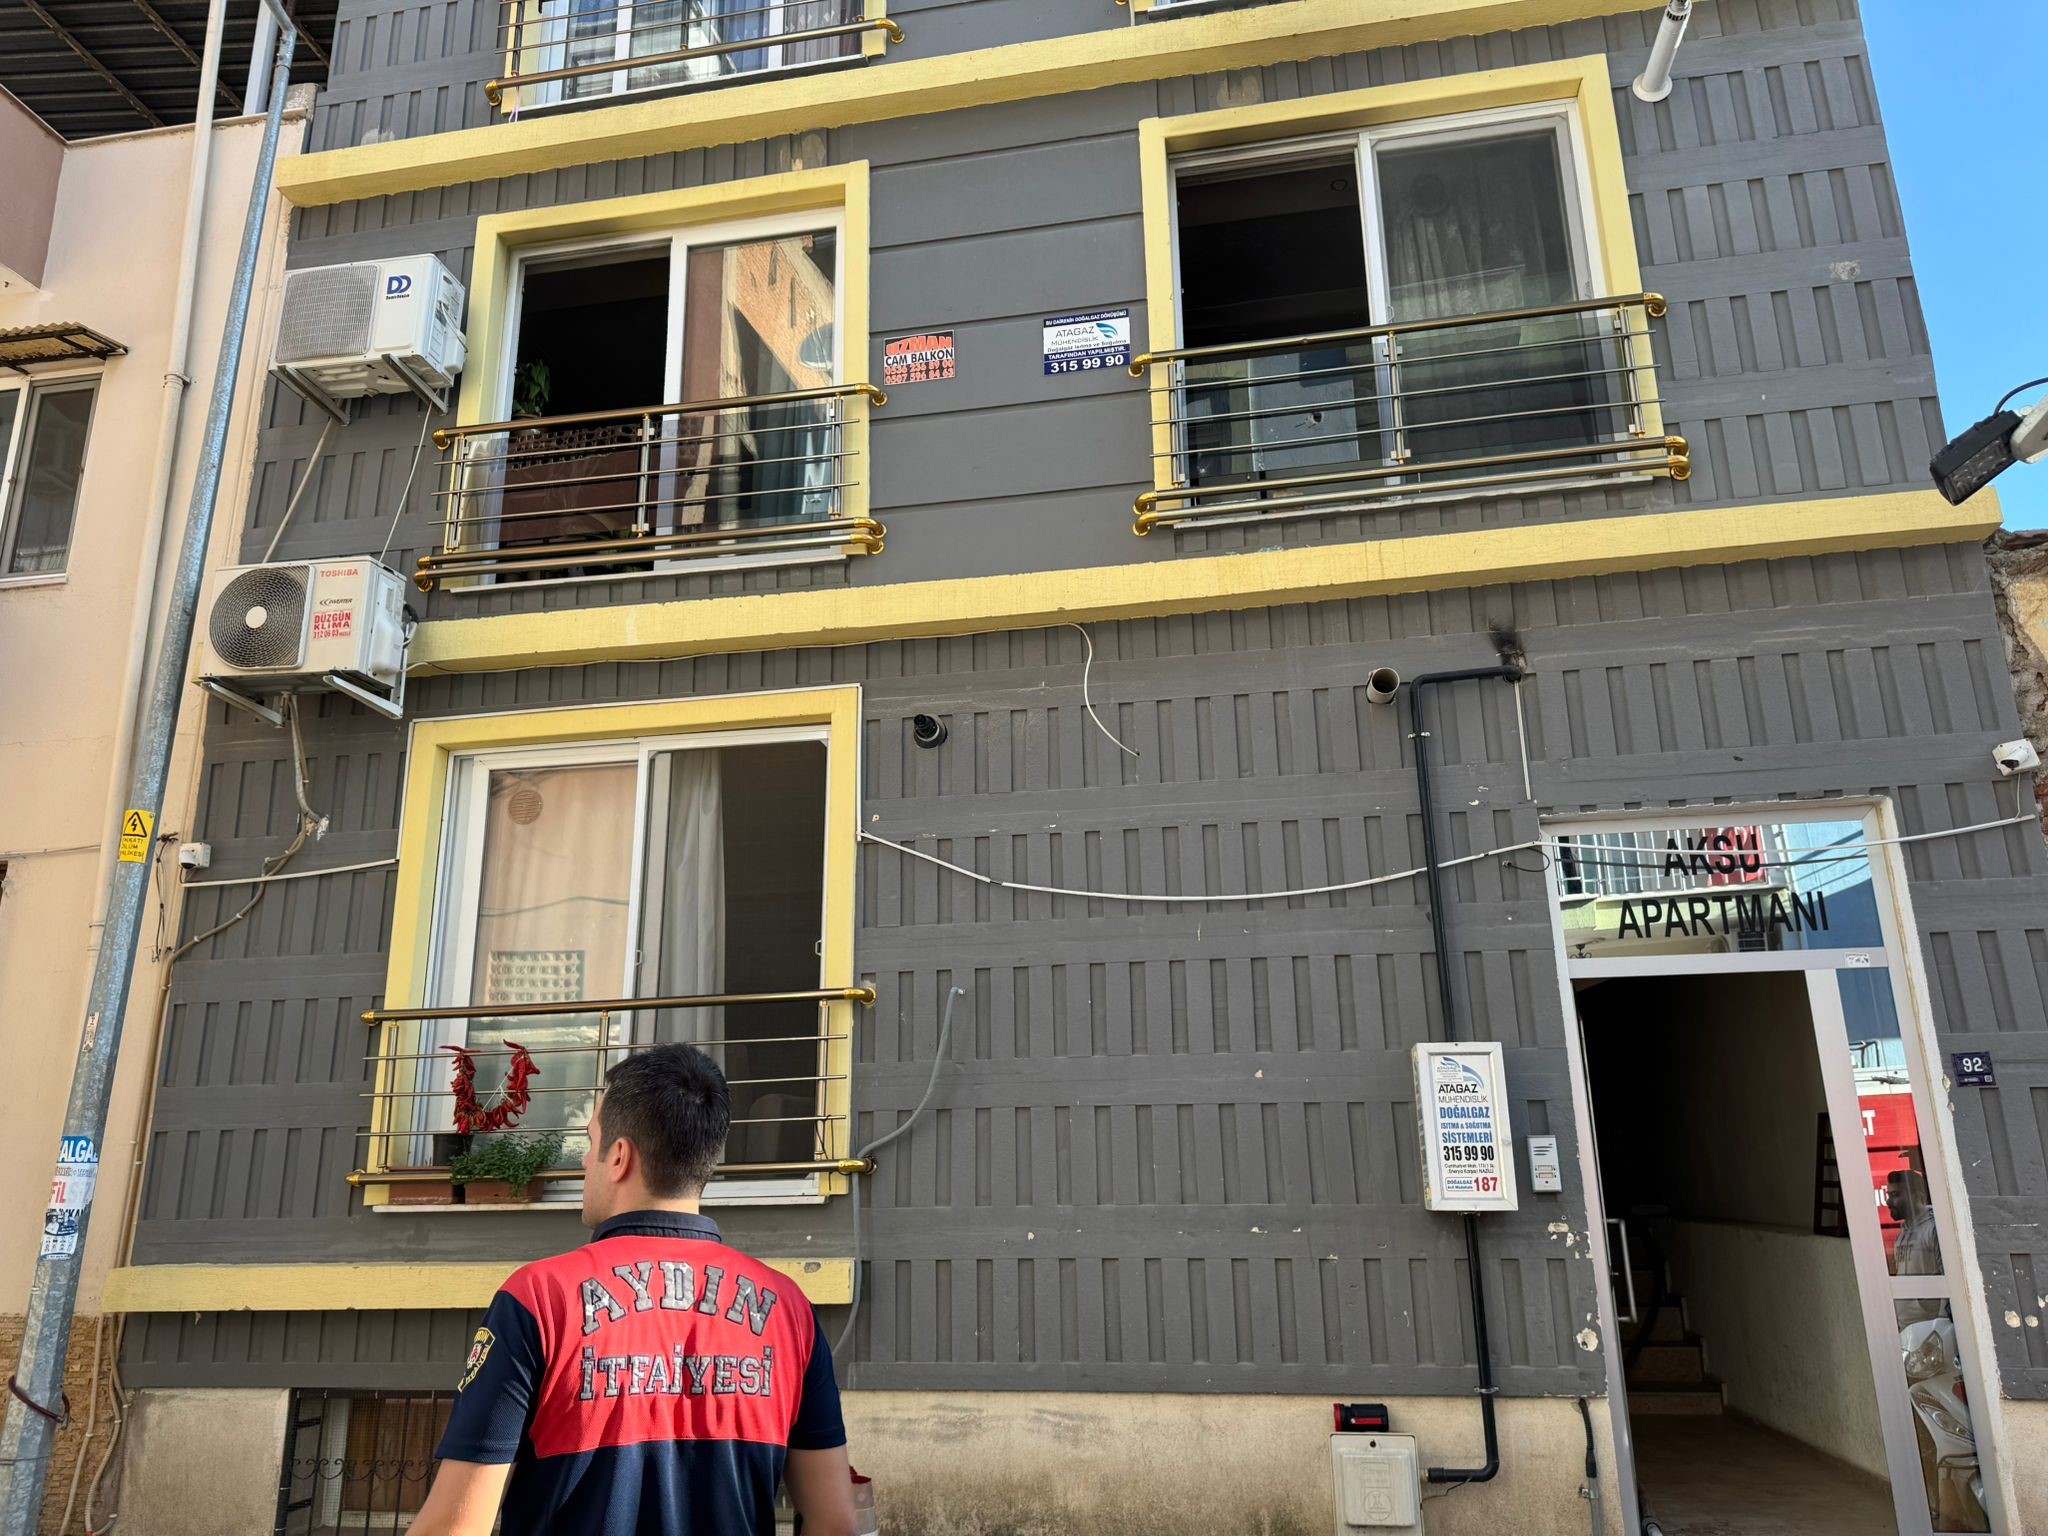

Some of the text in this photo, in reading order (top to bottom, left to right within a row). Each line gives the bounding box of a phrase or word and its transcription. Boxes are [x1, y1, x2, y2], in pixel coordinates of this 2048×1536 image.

[1055, 326, 1095, 338] ATAGAZ
[885, 336, 952, 356] UZMAN
[1051, 336, 1099, 346] MÜHENDİSLİK
[885, 349, 953, 366] CAM BALKON
[1050, 354, 1124, 373] 315 99 90
[320, 569, 358, 577] TOSHIBA
[315, 610, 351, 623] DÜZGÜN
[1664, 833, 1761, 877] AKSU
[1618, 890, 1829, 939] APARTMANI
[1962, 1057, 1984, 1072] 92
[1438, 1084, 1478, 1094] ATAGAZ
[1438, 1095, 1488, 1104] MÜHENDİSLİK
[1440, 1104, 1490, 1119] DOĞALGAZ
[1442, 1131, 1493, 1143] SİSTEMLERİ
[1443, 1146, 1495, 1161] 315 99 90
[1474, 1177, 1498, 1192] 187
[580, 1261, 777, 1336] AYDIN
[580, 1344, 774, 1400] İTFAİYESİ
